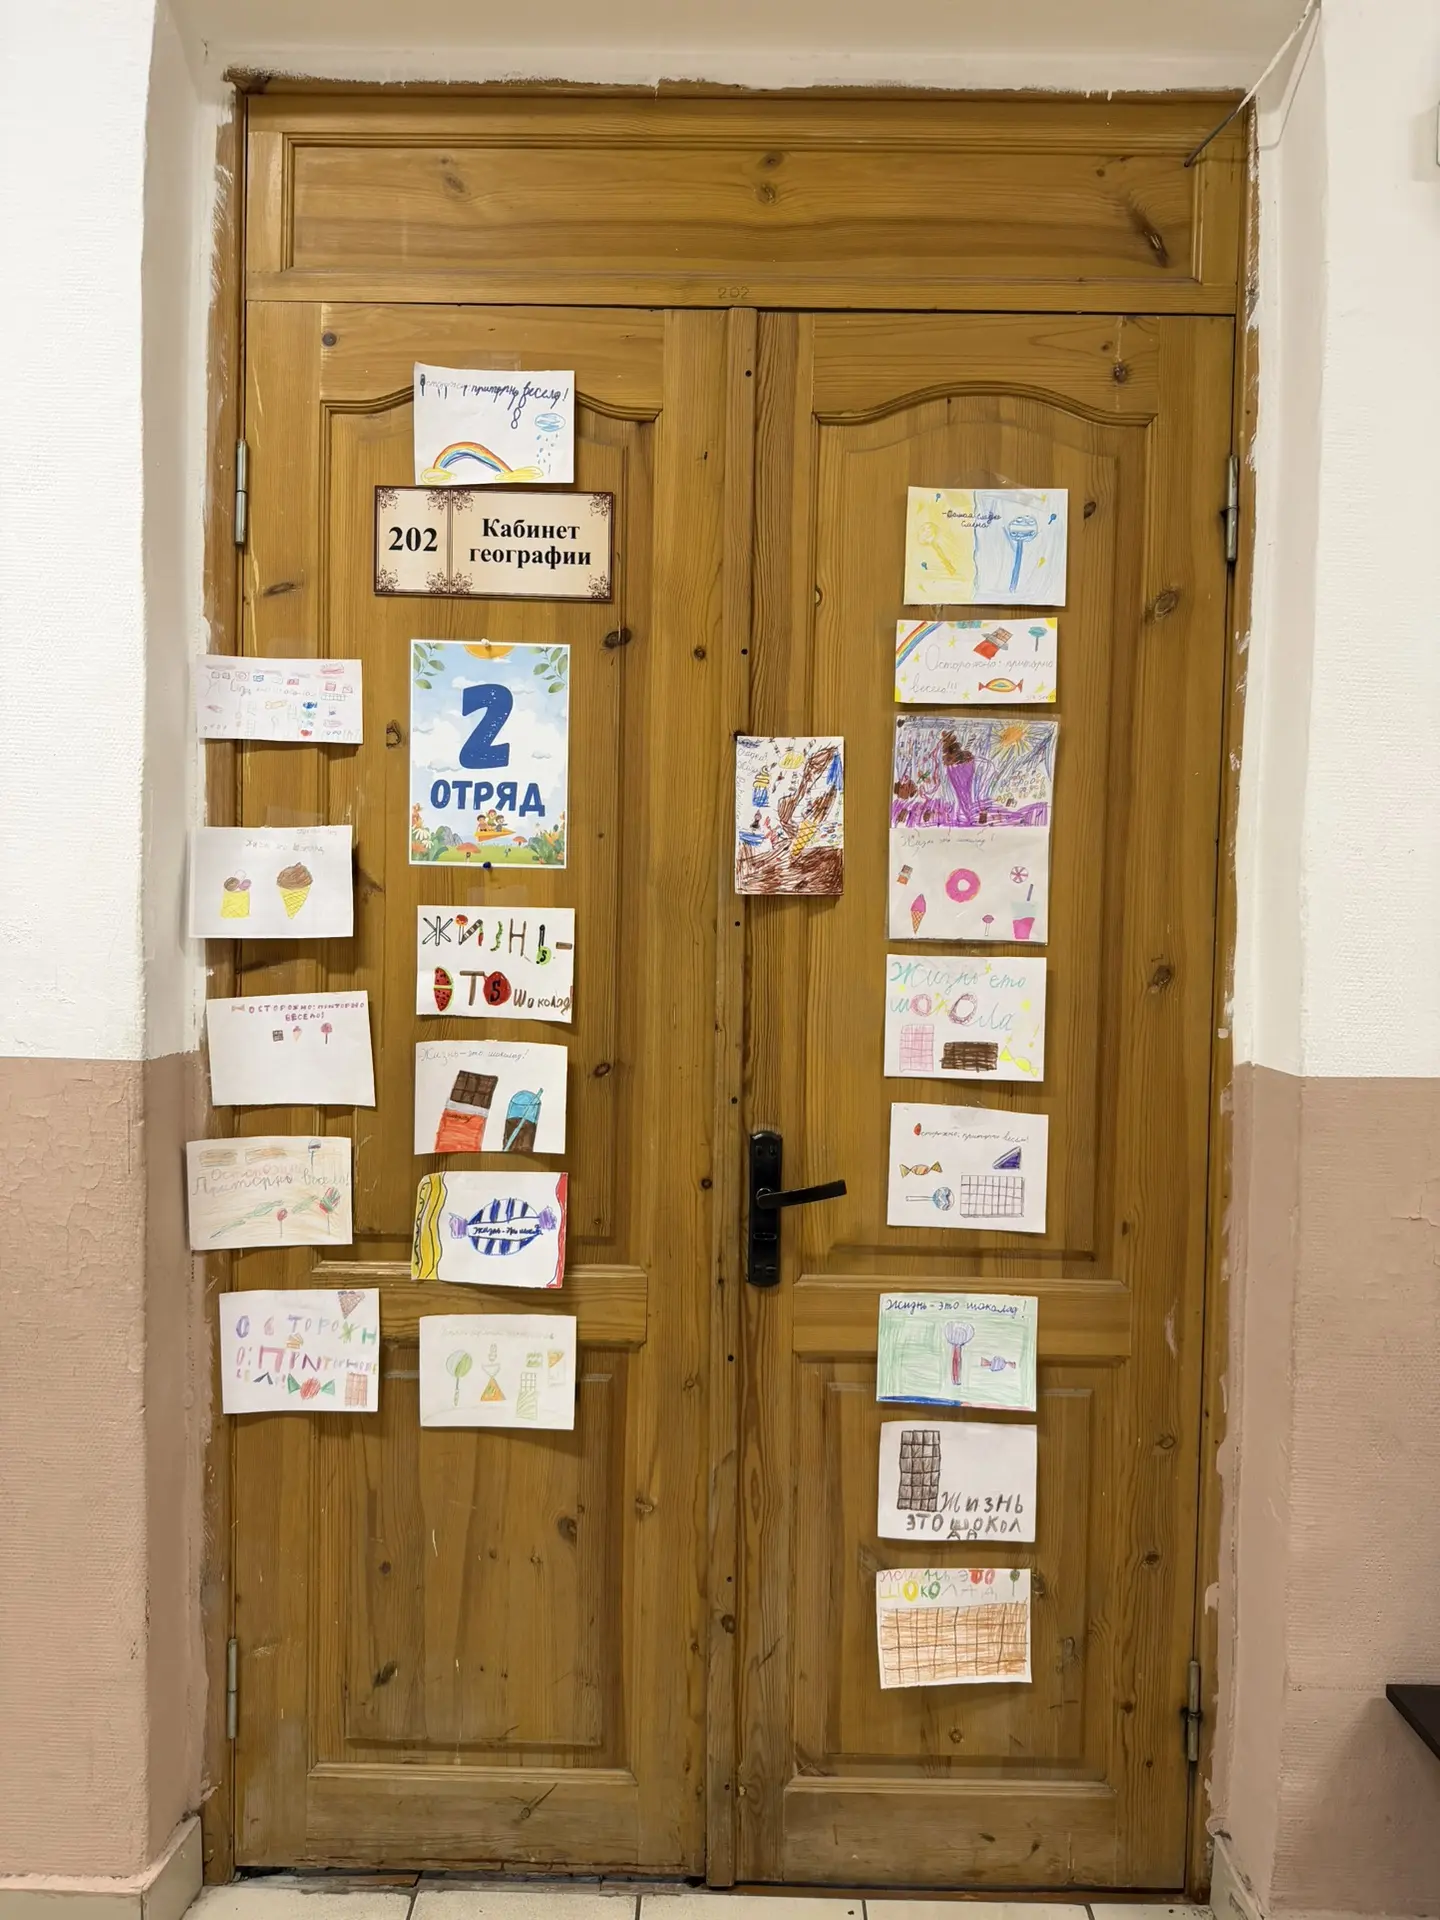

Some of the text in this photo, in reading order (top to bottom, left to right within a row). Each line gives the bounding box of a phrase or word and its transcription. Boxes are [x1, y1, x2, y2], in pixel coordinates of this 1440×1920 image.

[718, 285, 750, 299] 202
[388, 526, 438, 552] 202
[482, 518, 580, 540] Кабинет
[469, 546, 591, 570] географии
[459, 683, 514, 769] 2
[430, 779, 546, 817] ОТРЯД
